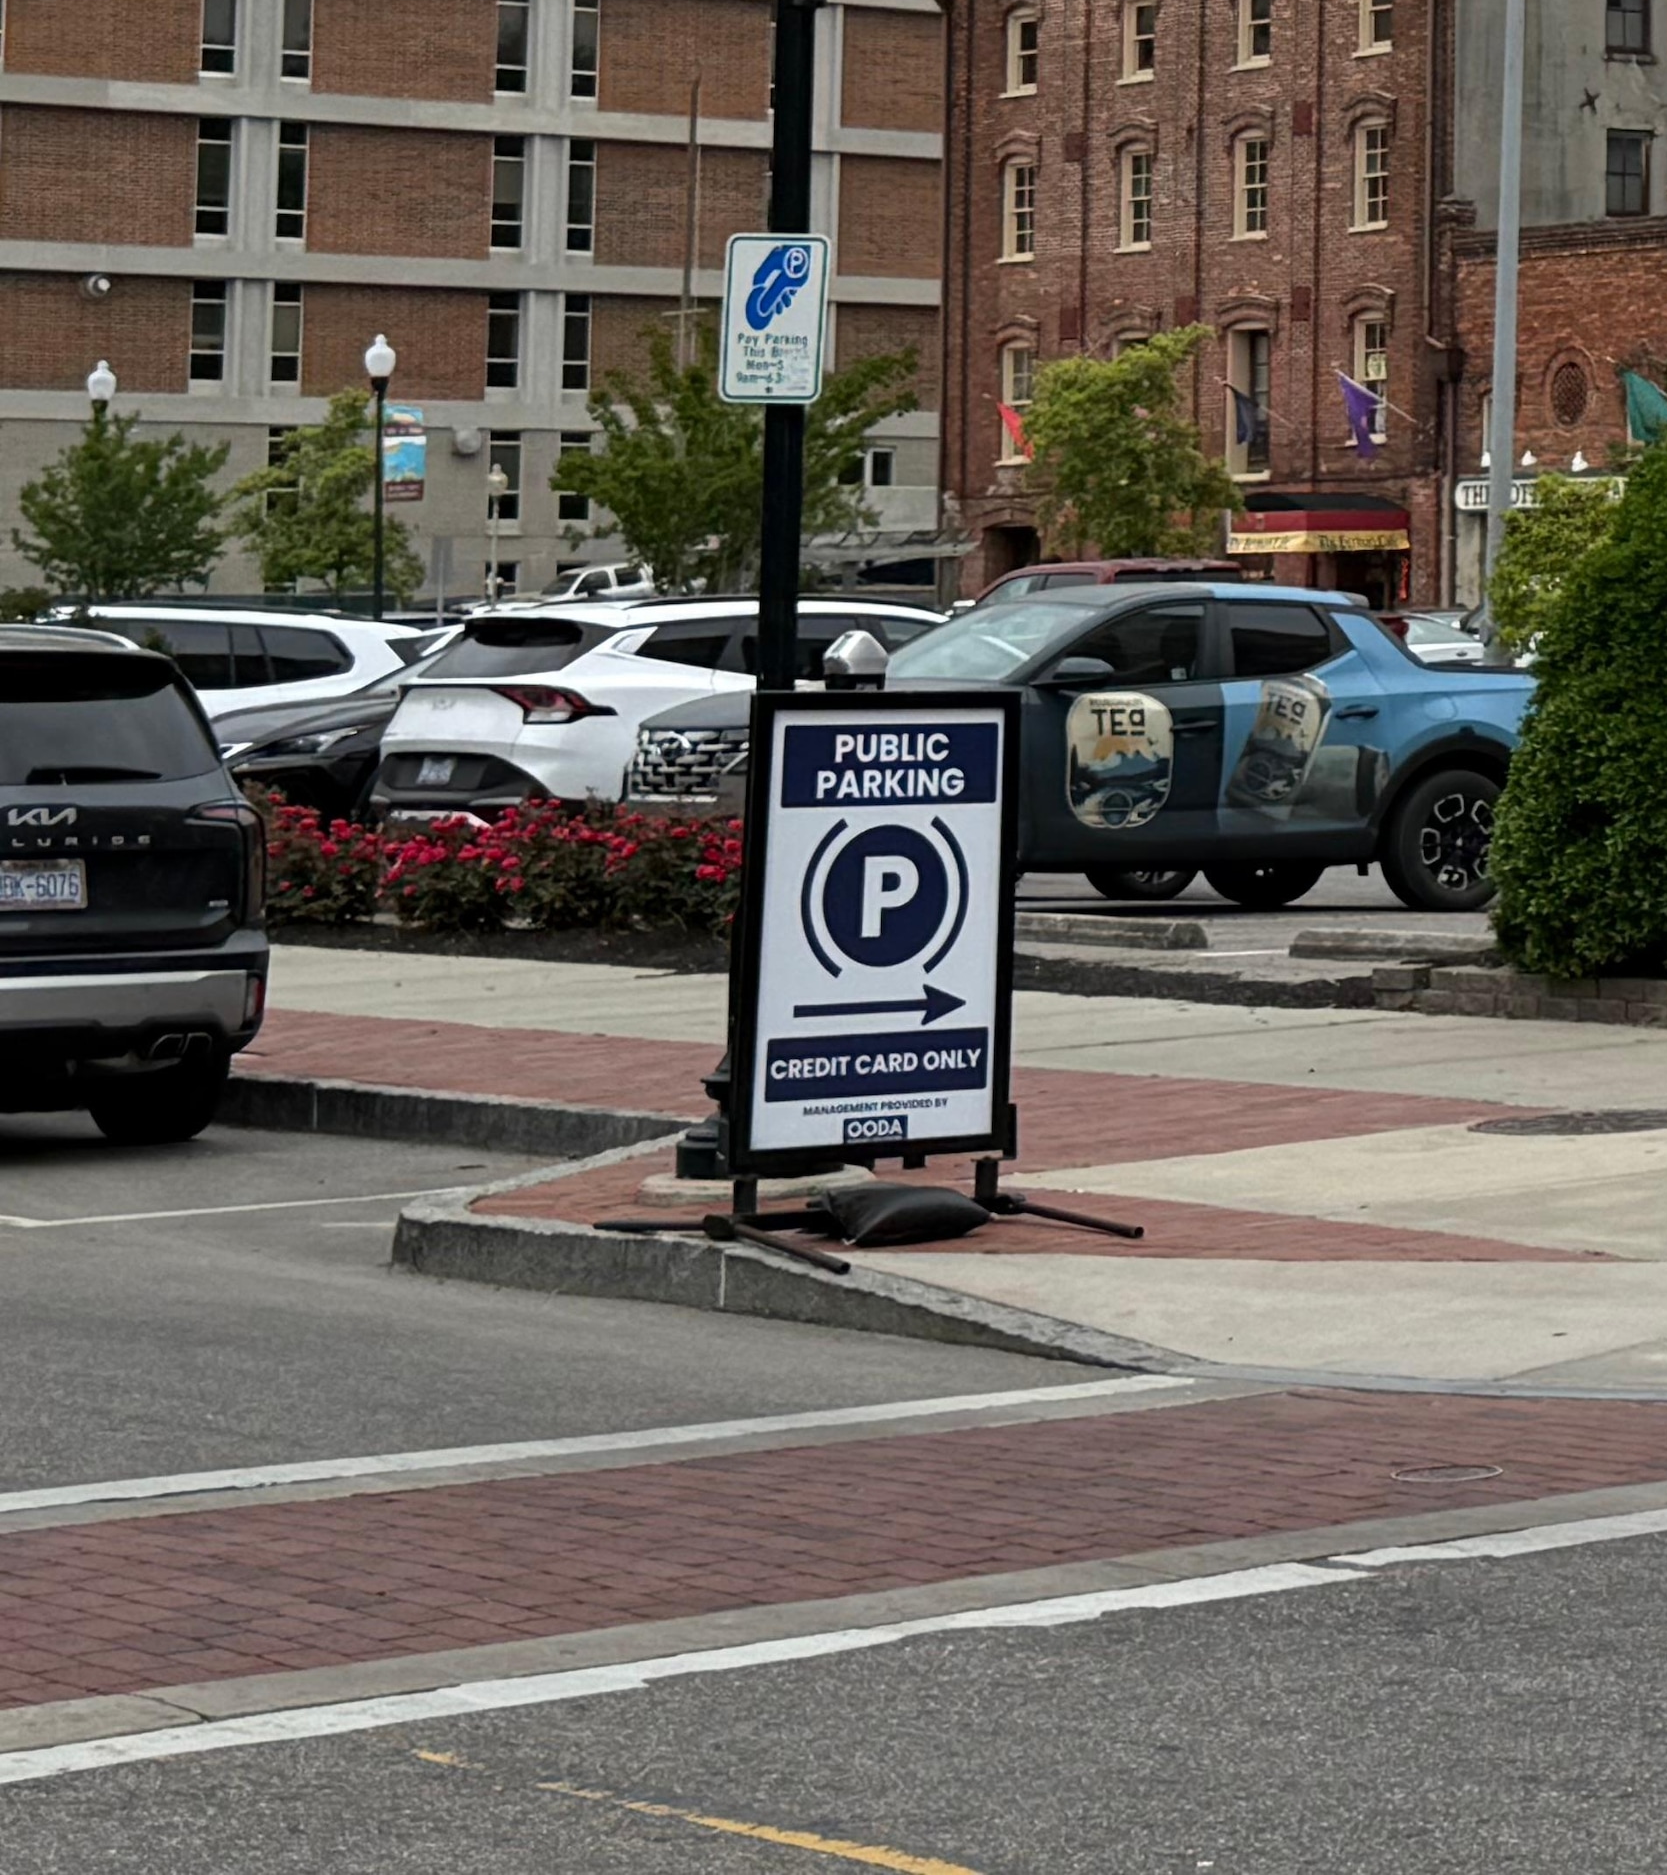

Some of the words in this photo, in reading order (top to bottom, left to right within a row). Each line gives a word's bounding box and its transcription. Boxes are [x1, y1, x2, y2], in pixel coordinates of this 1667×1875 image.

[737, 333, 760, 348] Pay
[764, 333, 809, 348] Parking
[743, 345, 766, 358] This
[834, 733, 950, 764] PUBLIC
[815, 767, 965, 800] PARKING
[860, 855, 920, 938] P
[770, 1055, 851, 1080] CREDIT
[855, 1052, 919, 1075] CARD
[922, 1048, 982, 1071] ONLY
[803, 1101, 879, 1116] MANAGEMENT
[881, 1098, 934, 1112] PROVIDED
[935, 1098, 949, 1108] BY
[847, 1118, 903, 1138] OODA
